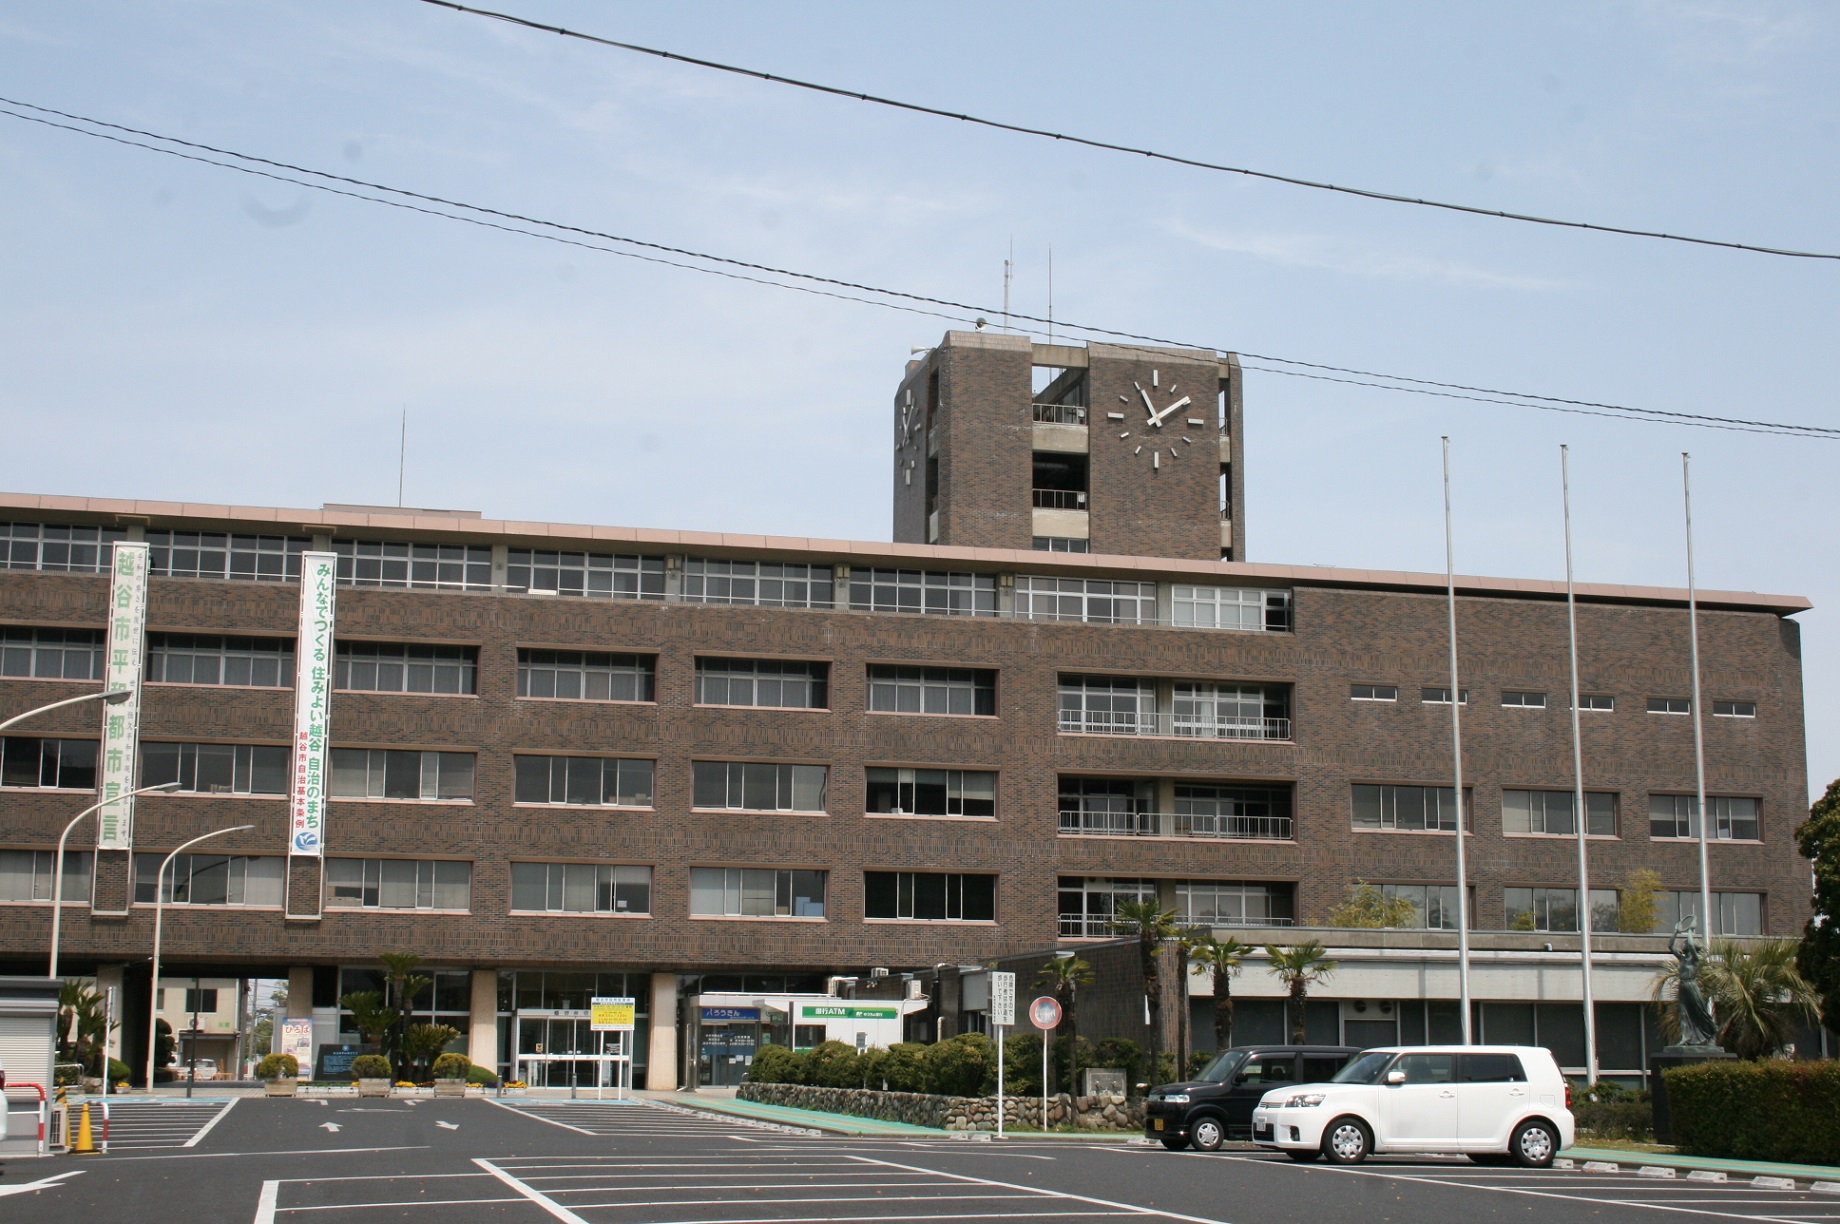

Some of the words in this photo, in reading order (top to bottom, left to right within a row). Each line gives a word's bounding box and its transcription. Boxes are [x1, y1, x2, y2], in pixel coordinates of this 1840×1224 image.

[313, 564, 331, 662] みんなでつくる
[308, 666, 326, 752] 住みよい越谷
[295, 731, 309, 829] 越谷市自治基本条例
[306, 757, 320, 829] 自治のまち
[713, 1009, 740, 1017] ろうきん
[815, 1007, 846, 1015] 銀行ATM
